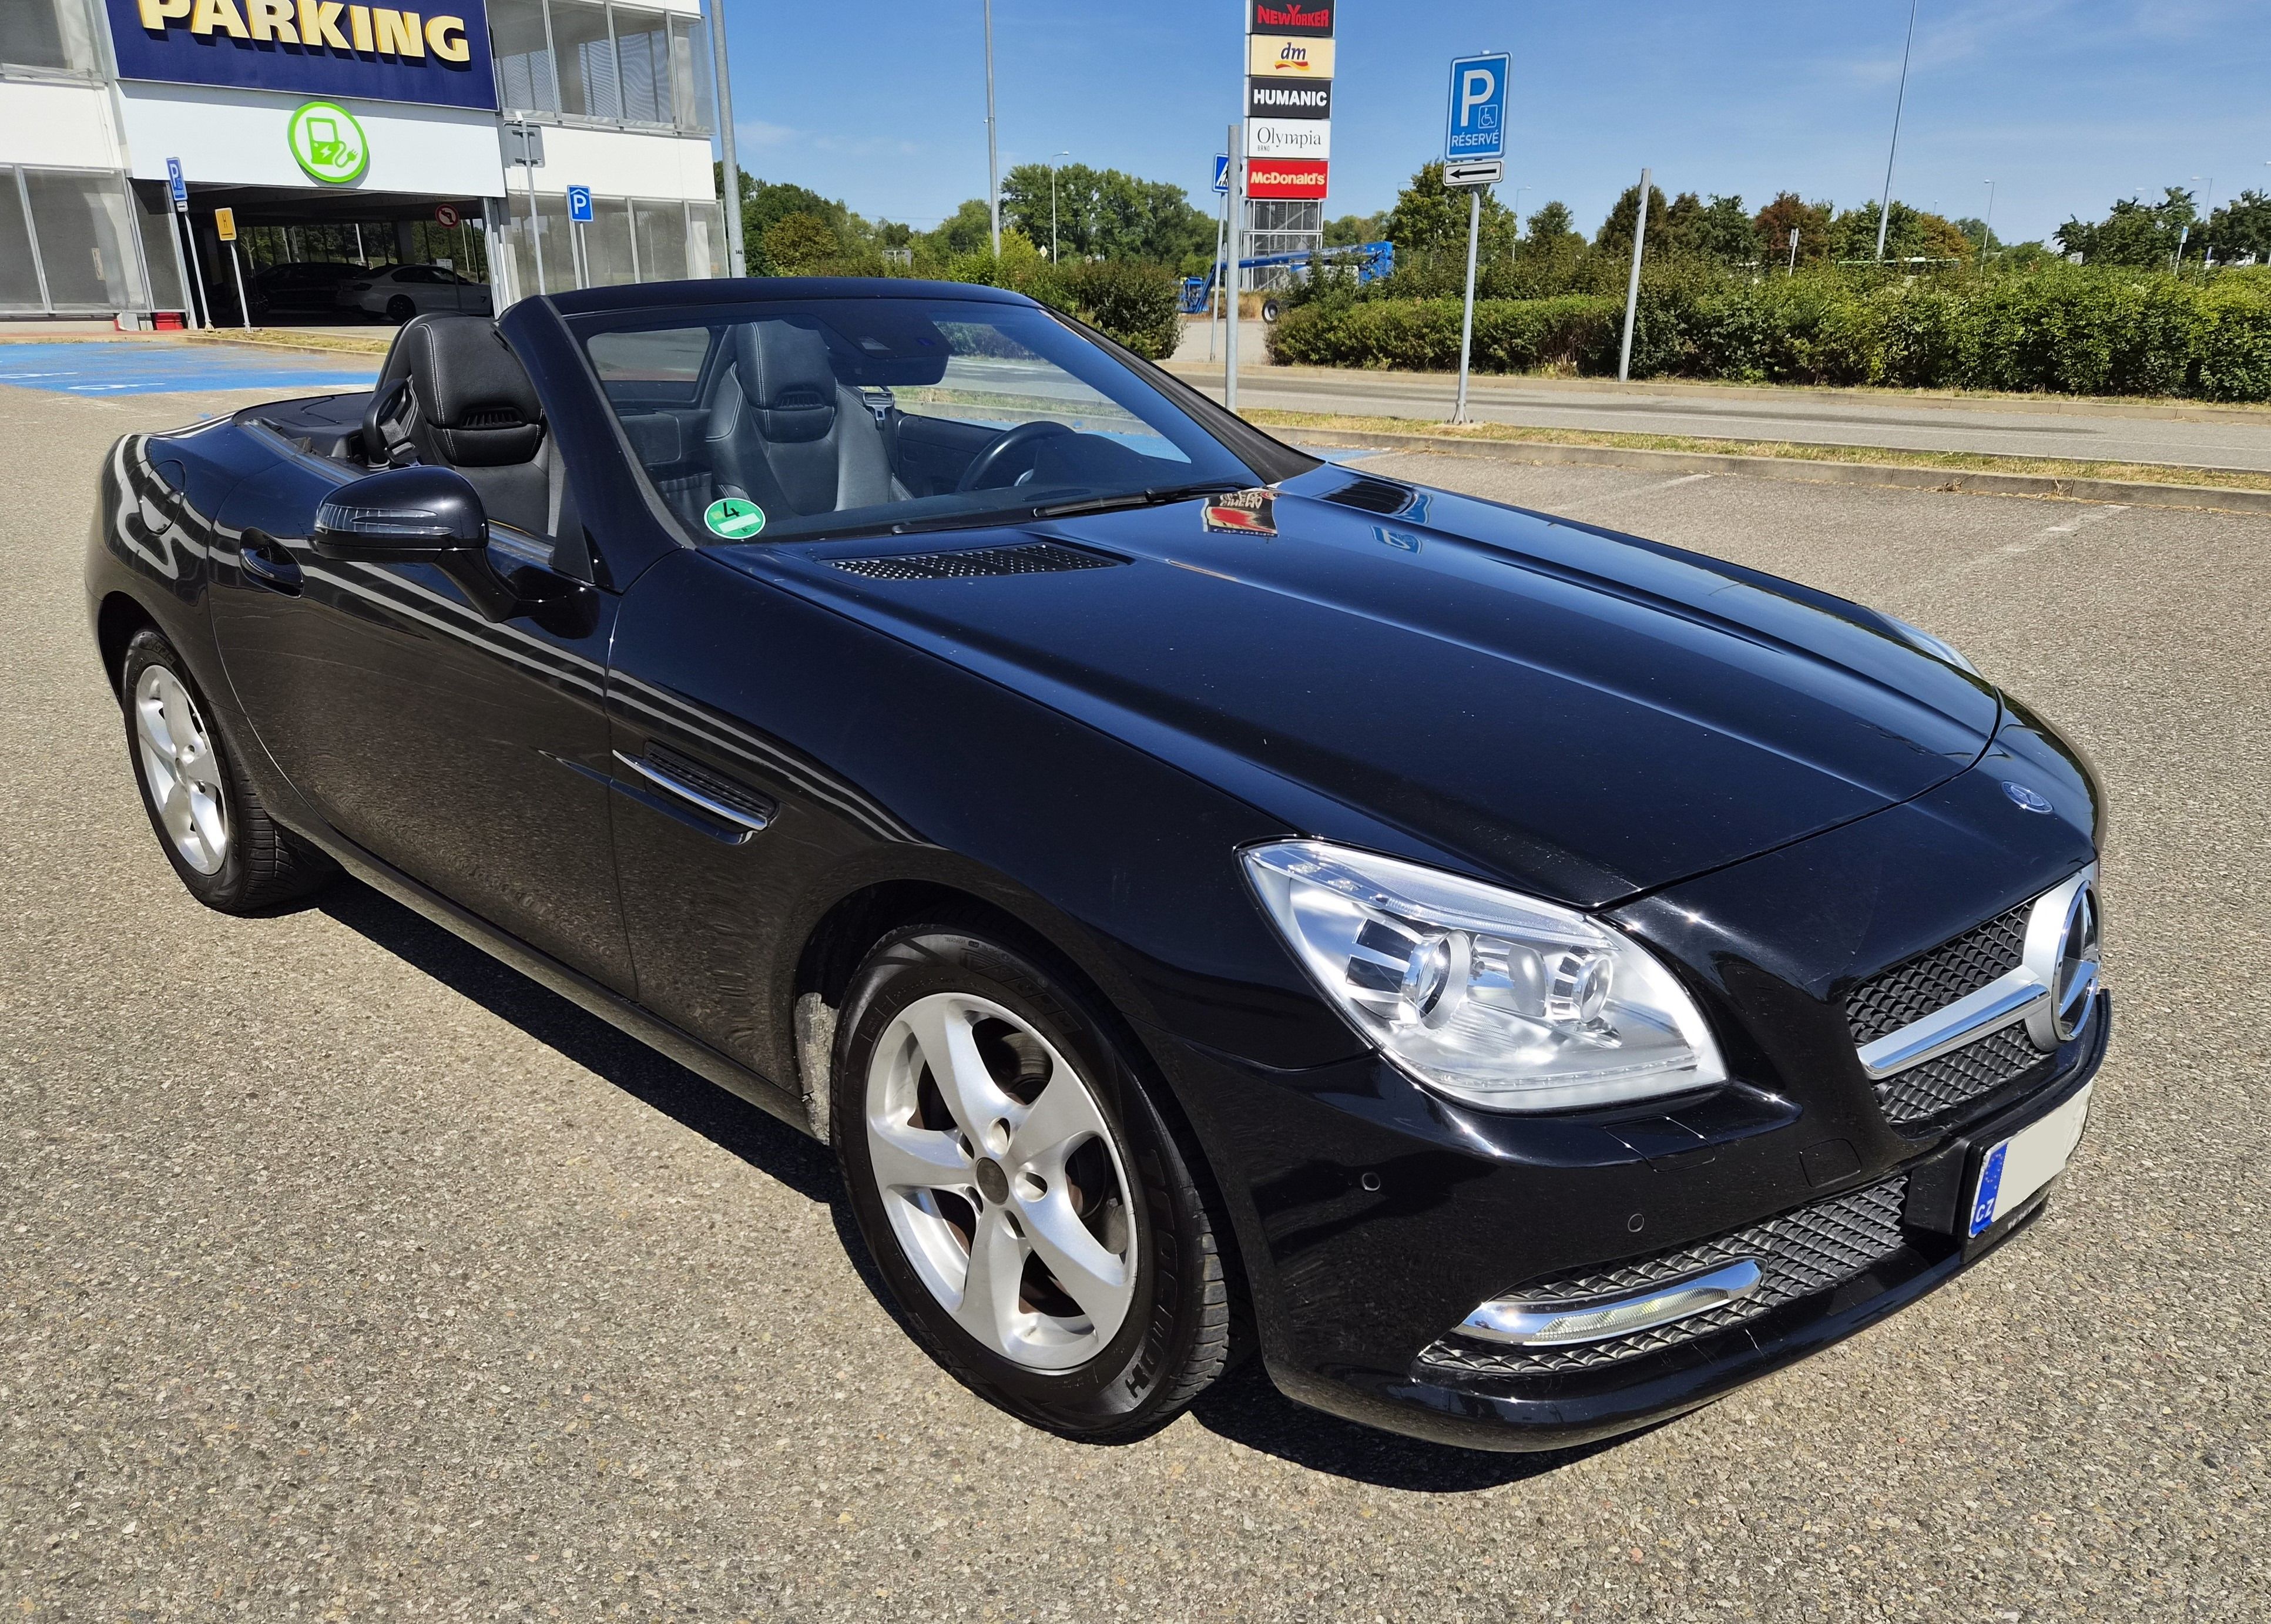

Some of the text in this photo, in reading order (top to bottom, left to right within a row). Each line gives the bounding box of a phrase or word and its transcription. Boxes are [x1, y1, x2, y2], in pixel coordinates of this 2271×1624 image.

[140, 0, 471, 62] PARKING
[1280, 42, 1307, 60] dm
[1253, 89, 1327, 106] HUMANIC
[1460, 69, 1495, 127] P
[1257, 126, 1321, 148] Olympia
[1451, 129, 1500, 147] RÉSERVÉ
[170, 163, 179, 187] P
[1250, 171, 1326, 185] McDonald's
[573, 194, 587, 214] P
[723, 502, 740, 518] 4
[1975, 1197, 1995, 1223] CZ
